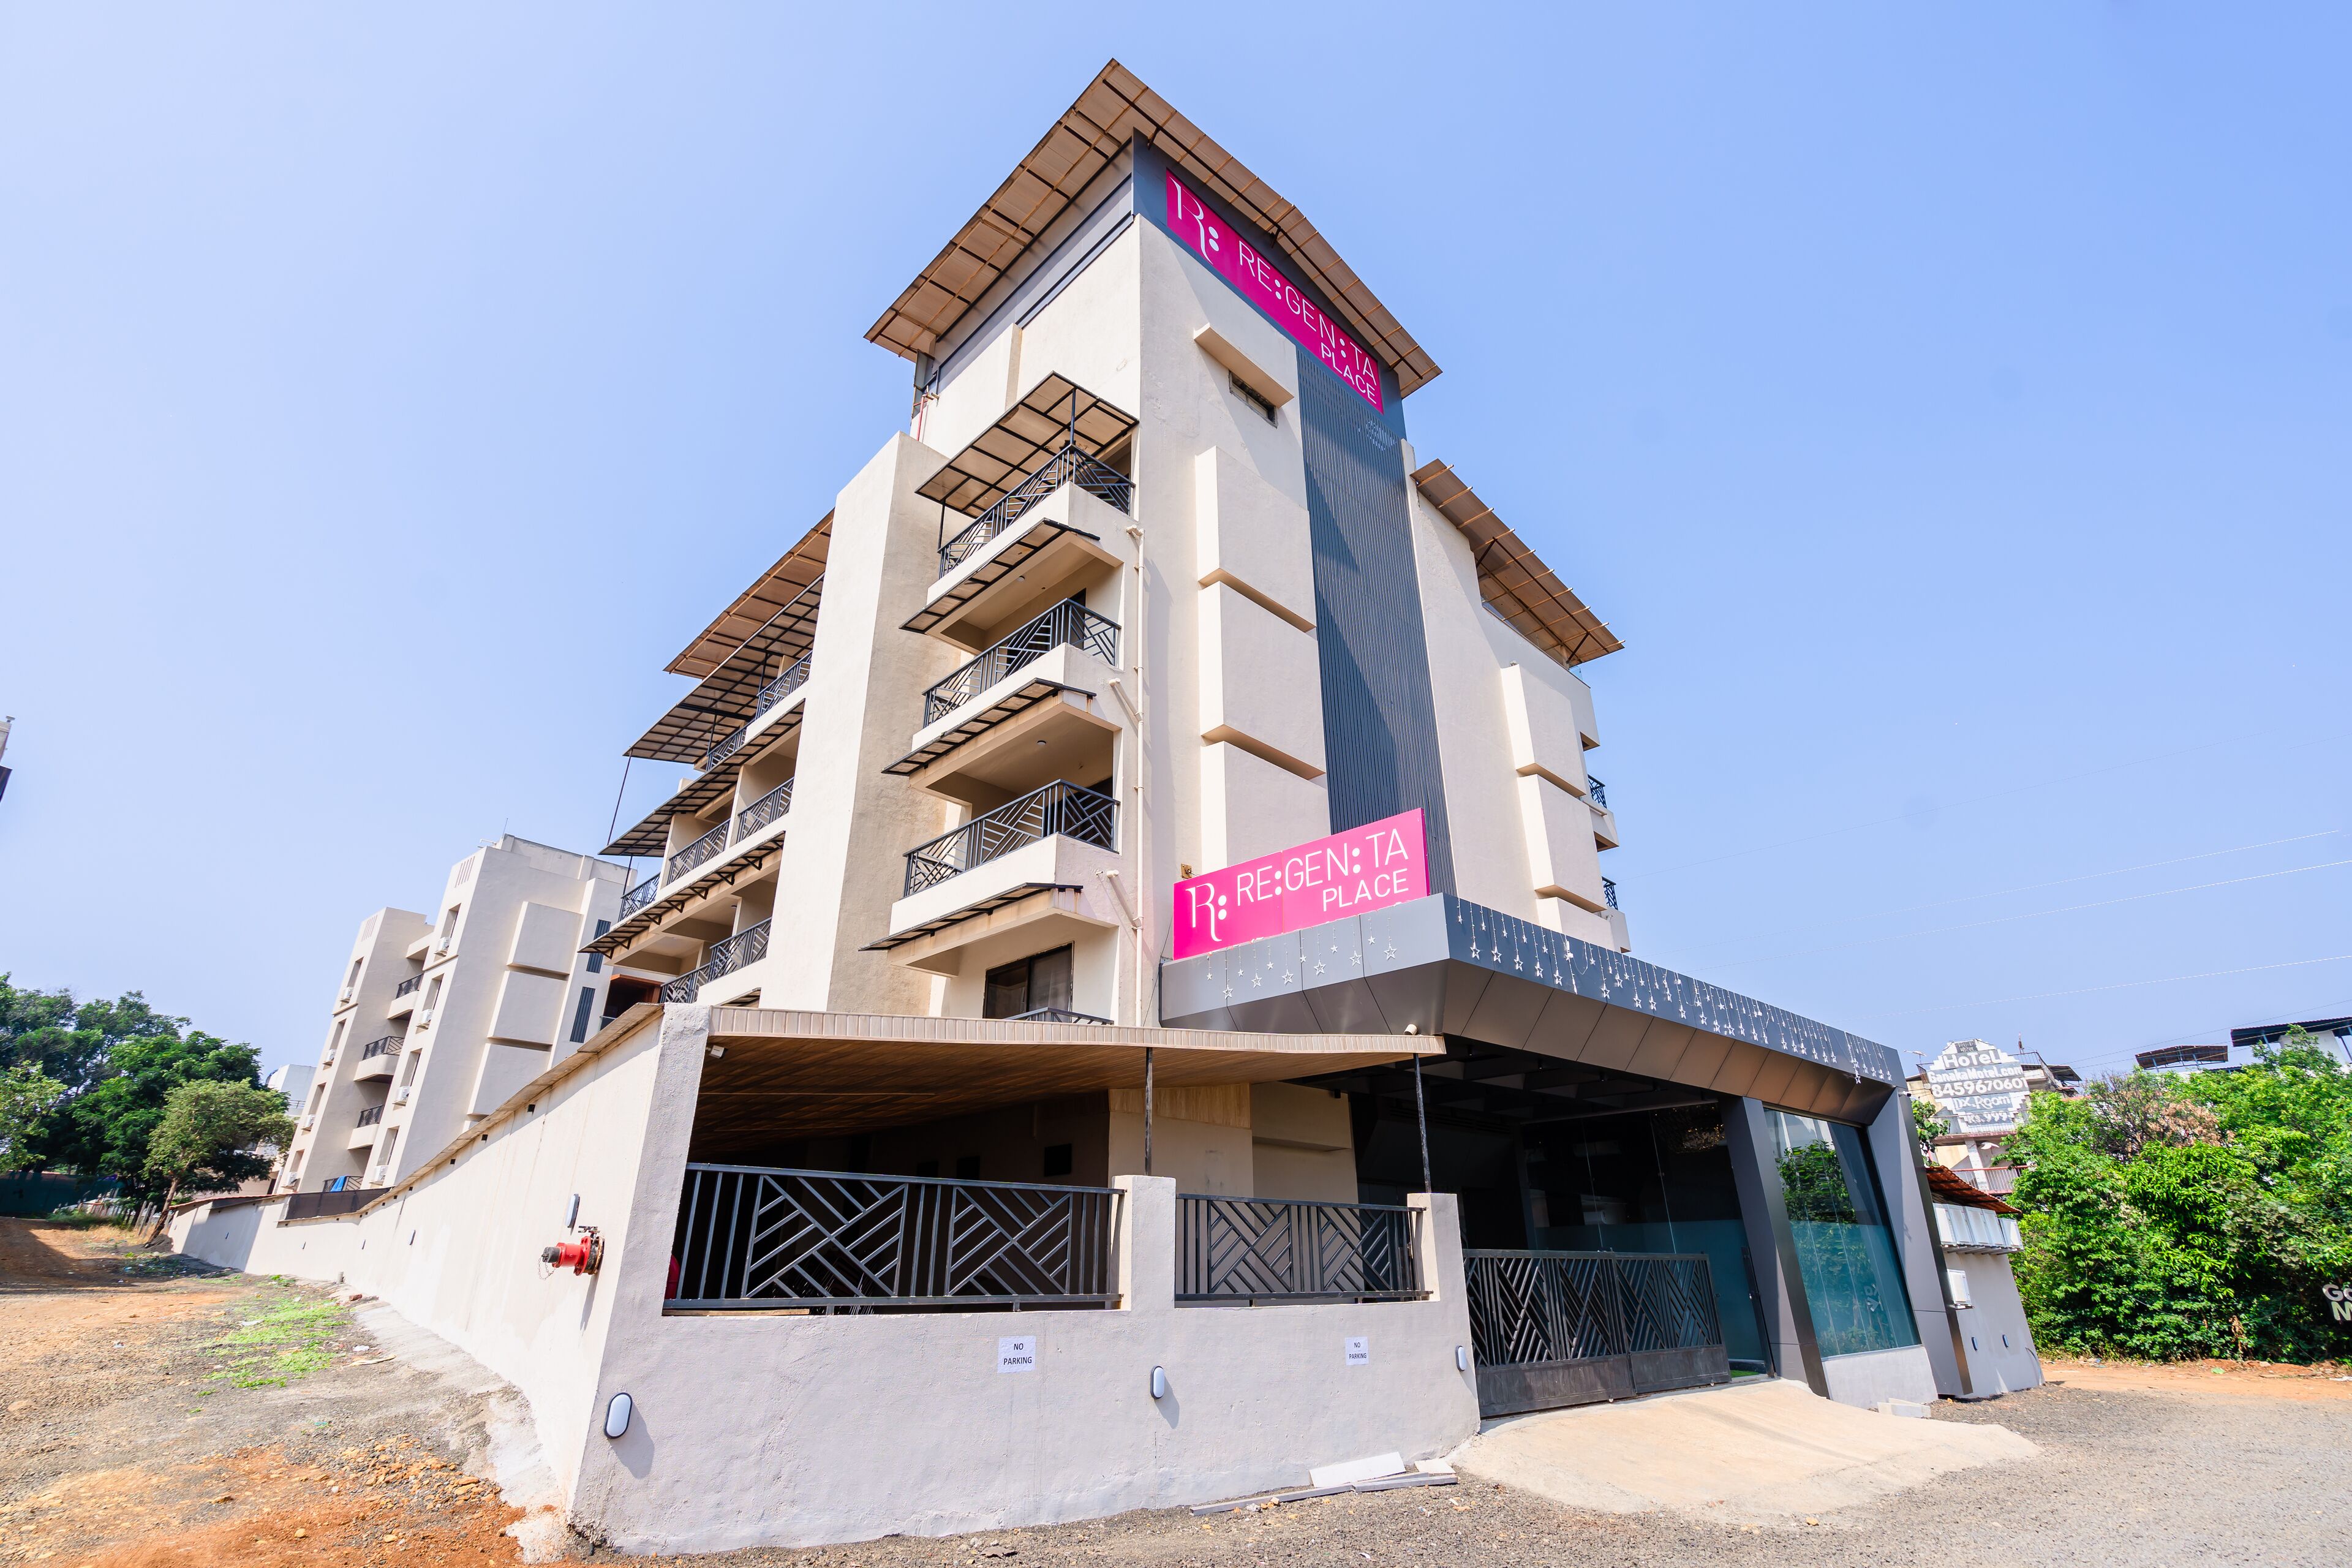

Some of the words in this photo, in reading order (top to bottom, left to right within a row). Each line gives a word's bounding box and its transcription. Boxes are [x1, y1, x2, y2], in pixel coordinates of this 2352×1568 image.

[1321, 341, 1378, 405] PLACE
[1322, 868, 1409, 912] PLACE
[1931, 1077, 2029, 1098] 8459670601
[1003, 1356, 1032, 1365] PARKING
